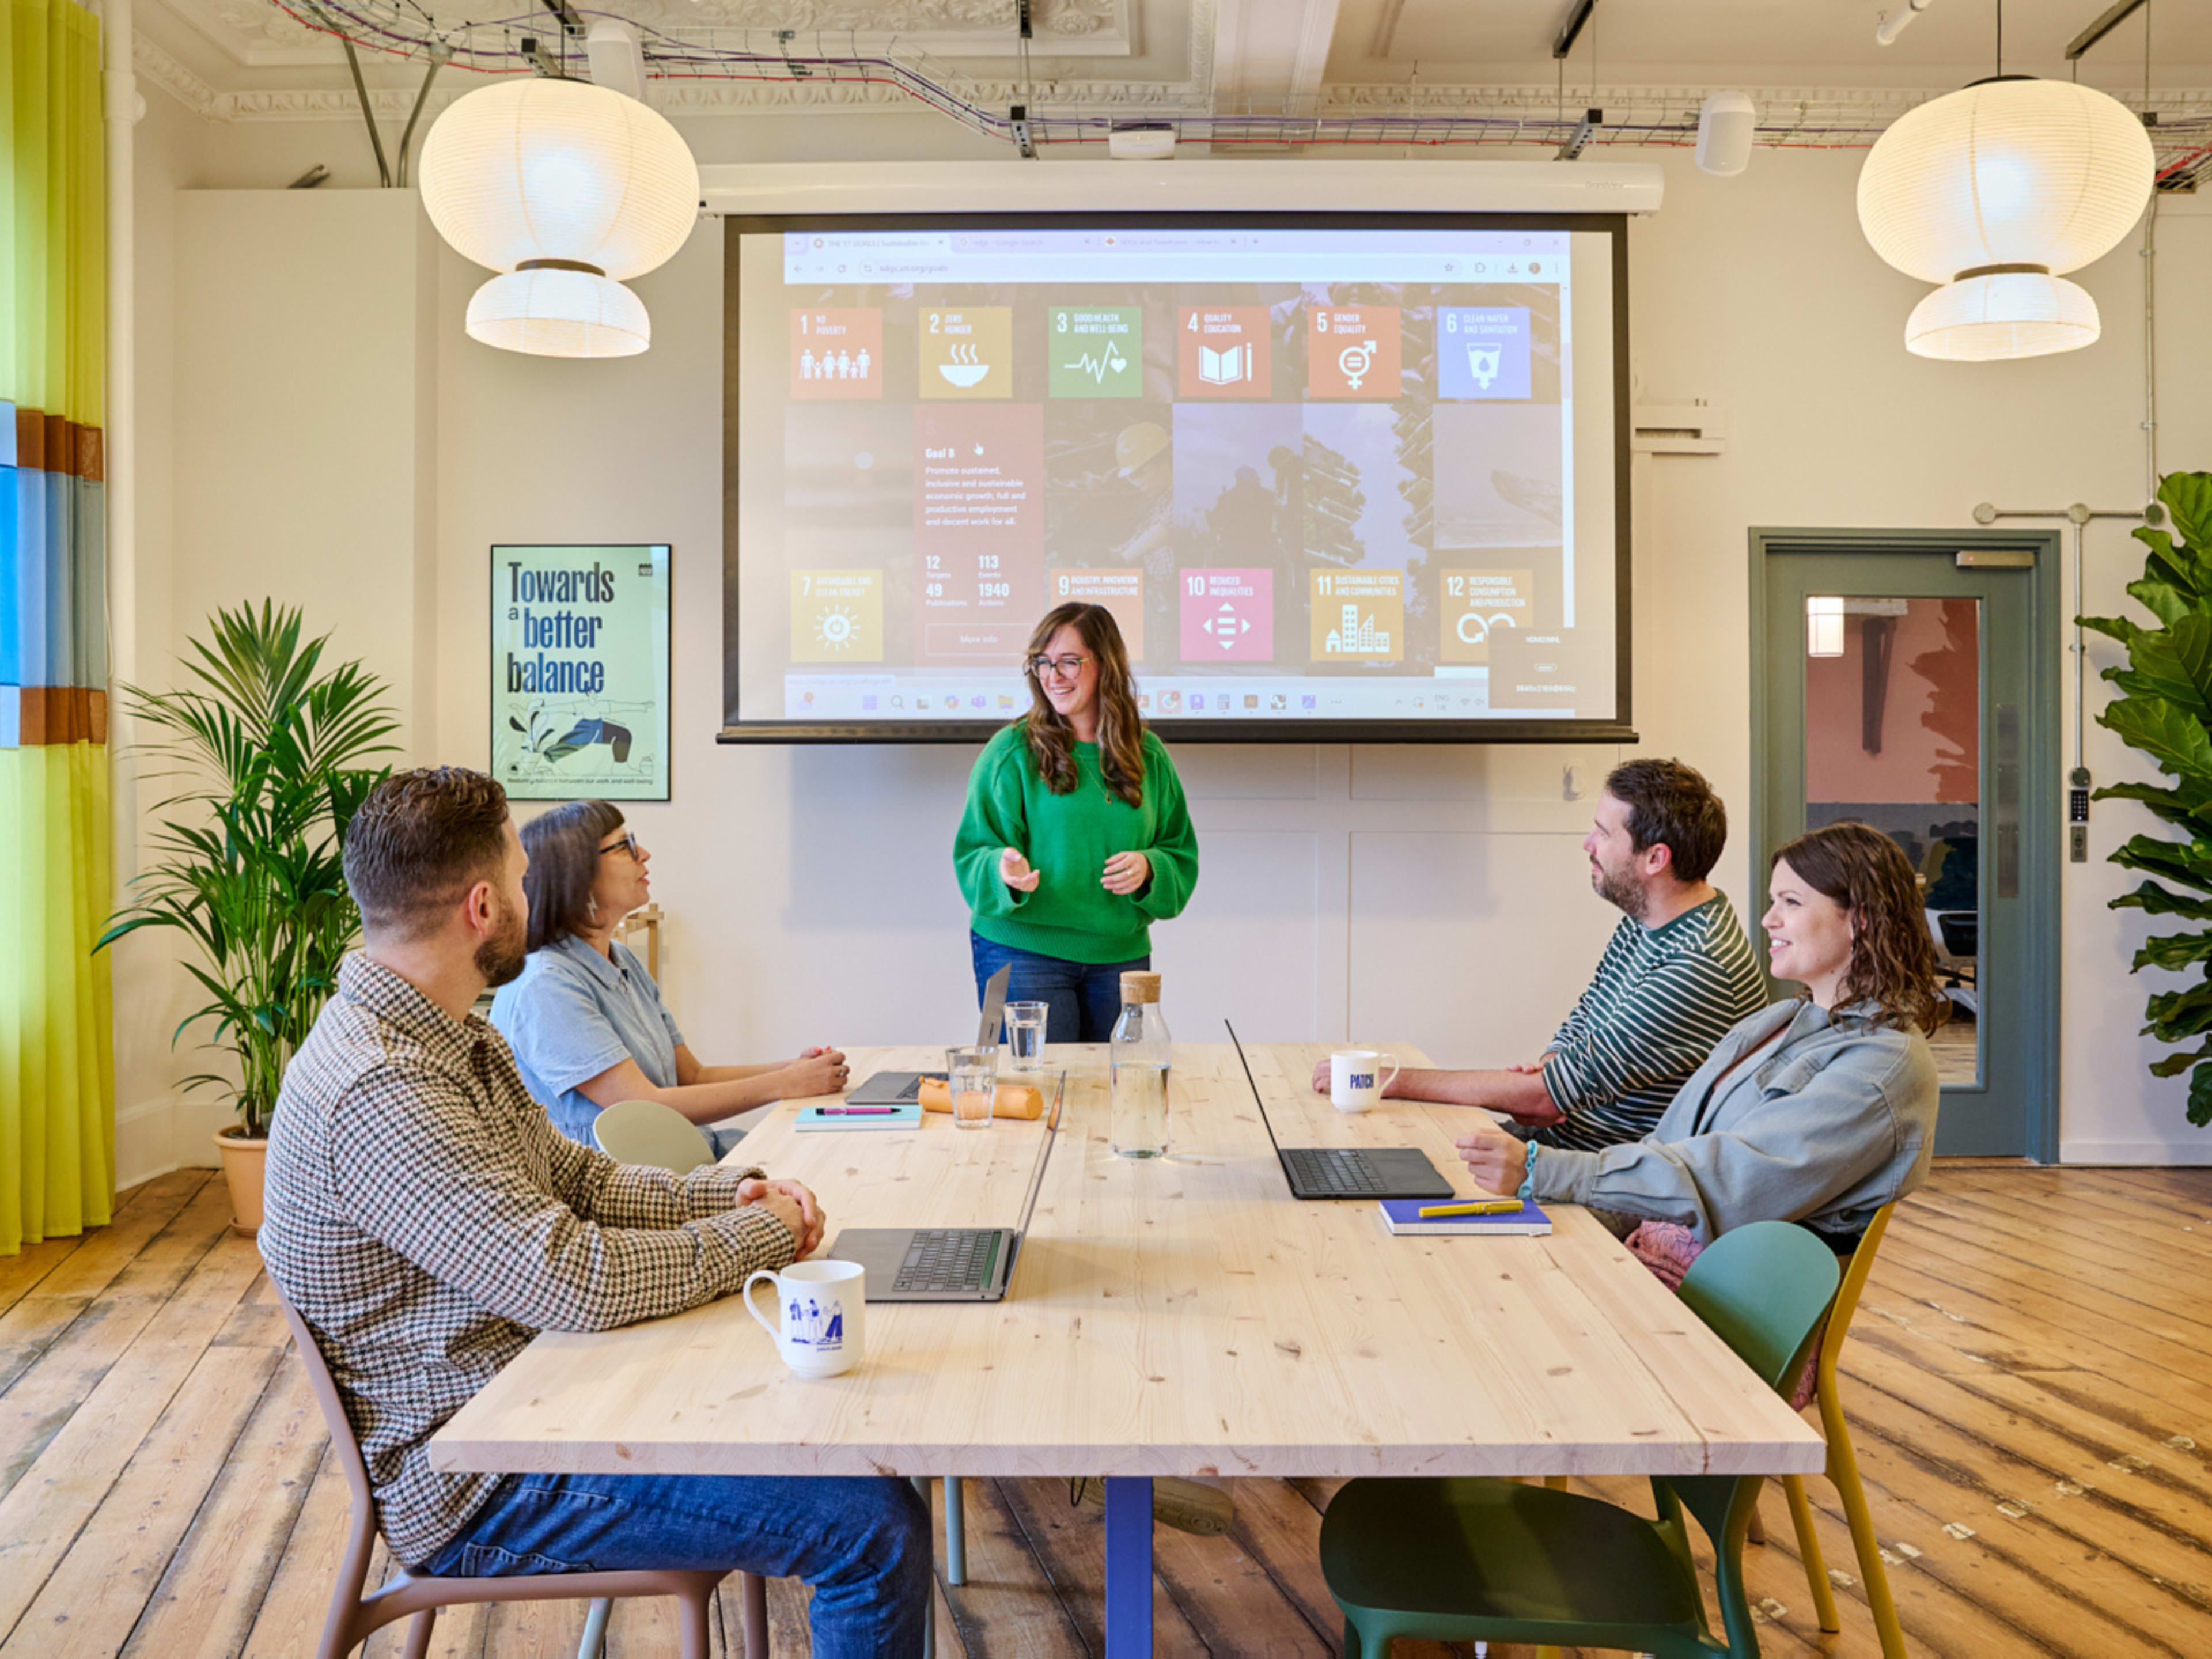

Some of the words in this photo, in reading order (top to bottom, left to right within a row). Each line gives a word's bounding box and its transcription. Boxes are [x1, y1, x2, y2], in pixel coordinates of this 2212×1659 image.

[929, 313, 940, 334] 2
[945, 314, 963, 323] ZERO
[1056, 313, 1067, 333] 3
[1188, 312, 1199, 332] 4
[1203, 313, 1232, 323] QUALITY
[1317, 312, 1328, 333] 5
[1334, 313, 1361, 323] GENDER
[1446, 313, 1457, 334] 6
[800, 313, 808, 335] 1
[945, 324, 972, 335] HUNGER
[1203, 324, 1242, 334] EDUCATION
[1334, 324, 1366, 334] EQUALITY
[816, 325, 847, 335] POVERTY
[925, 448, 946, 459] Goal
[948, 448, 955, 459] 8
[925, 466, 959, 475] Promote
[925, 479, 960, 488] inclusive
[961, 479, 978, 488] and
[978, 479, 1024, 488] sustainable
[925, 493, 964, 501] economic
[996, 491, 1009, 500] full
[1010, 491, 1027, 500] and
[925, 505, 967, 515] productive
[968, 505, 1017, 515] employment
[925, 517, 941, 526] and
[941, 517, 969, 526] decent
[970, 517, 990, 526] work
[991, 517, 1003, 526] for
[925, 555, 941, 570] 12
[978, 555, 1000, 570] 113
[508, 561, 615, 603] Towards
[1209, 575, 1241, 585] REDUCED
[1335, 575, 1377, 585] SUSTAINABLE
[1378, 575, 1399, 585] CITIES
[1469, 575, 1513, 586] RESPONSIBLE
[801, 576, 812, 597] 7
[925, 582, 943, 597] 49
[978, 582, 1010, 597] 1940
[1058, 576, 1069, 596] 9
[1187, 575, 1205, 597] 10
[1209, 586, 1254, 596] INEQUALITIES
[1317, 575, 1332, 597] 11
[1336, 586, 1350, 596] AND
[1350, 586, 1397, 596] COMMUNITIES
[1447, 575, 1464, 597] 12
[1469, 586, 1517, 596] CONSUMPTION
[508, 607, 519, 620] a
[524, 607, 603, 649] better
[507, 652, 604, 694] balance
